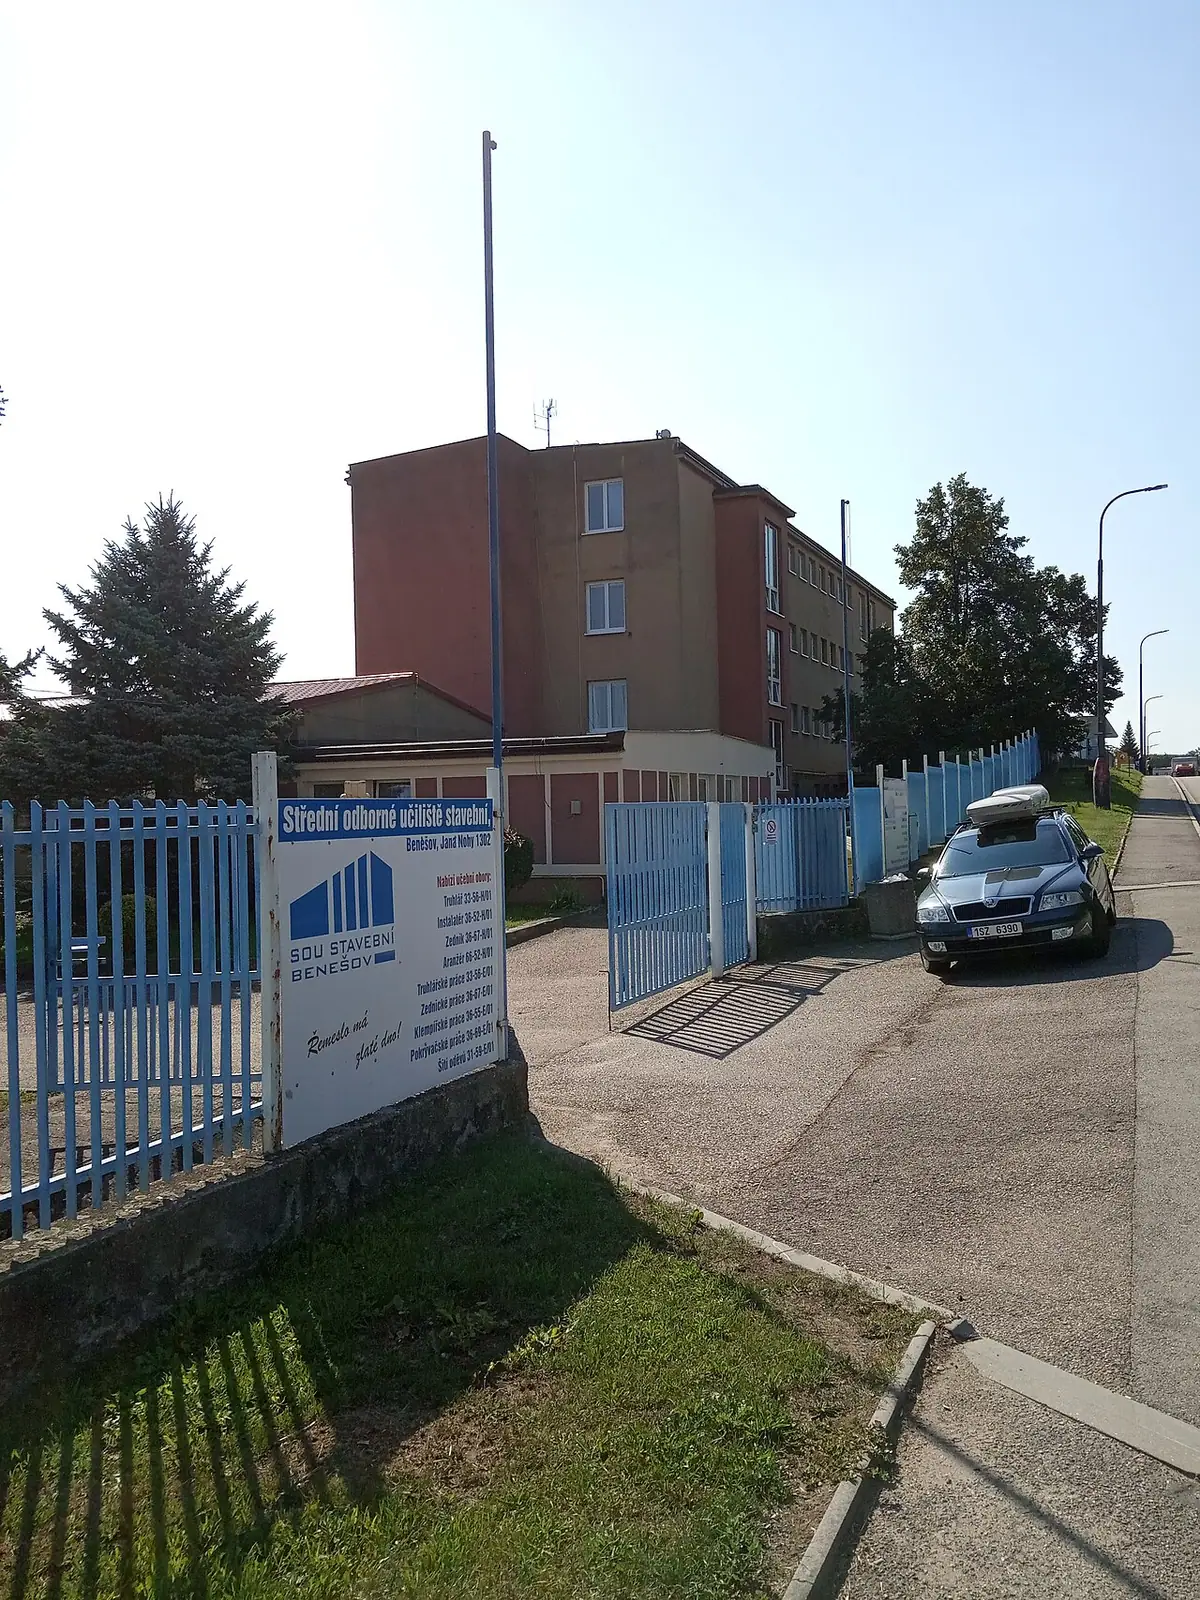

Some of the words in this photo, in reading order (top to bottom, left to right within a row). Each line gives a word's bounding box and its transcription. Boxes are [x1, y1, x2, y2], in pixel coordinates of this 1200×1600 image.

[283, 804, 339, 833] Střední
[343, 804, 397, 831] odborné
[400, 803, 443, 829] učiliště
[445, 803, 491, 828] stavební,
[406, 836, 439, 852] Benešov,
[440, 835, 457, 850] Jana
[458, 834, 474, 849] Nohy
[475, 833, 491, 847] 1302
[974, 927, 990, 937] 1SZ
[996, 923, 1018, 934] 6390
[290, 944, 323, 963] SOU
[330, 926, 394, 956] STAVEBNÍ
[292, 954, 372, 983] BENEŠOV
[449, 974, 465, 989] práce
[420, 996, 448, 1016] Zednické
[449, 994, 465, 1009] práce
[449, 1013, 465, 1029] práce
[307, 1022, 350, 1058] Řemeslo
[353, 1009, 369, 1032] má
[449, 1031, 465, 1049] práce
[355, 1034, 379, 1070] zlaté
[381, 1021, 402, 1048] dno!
